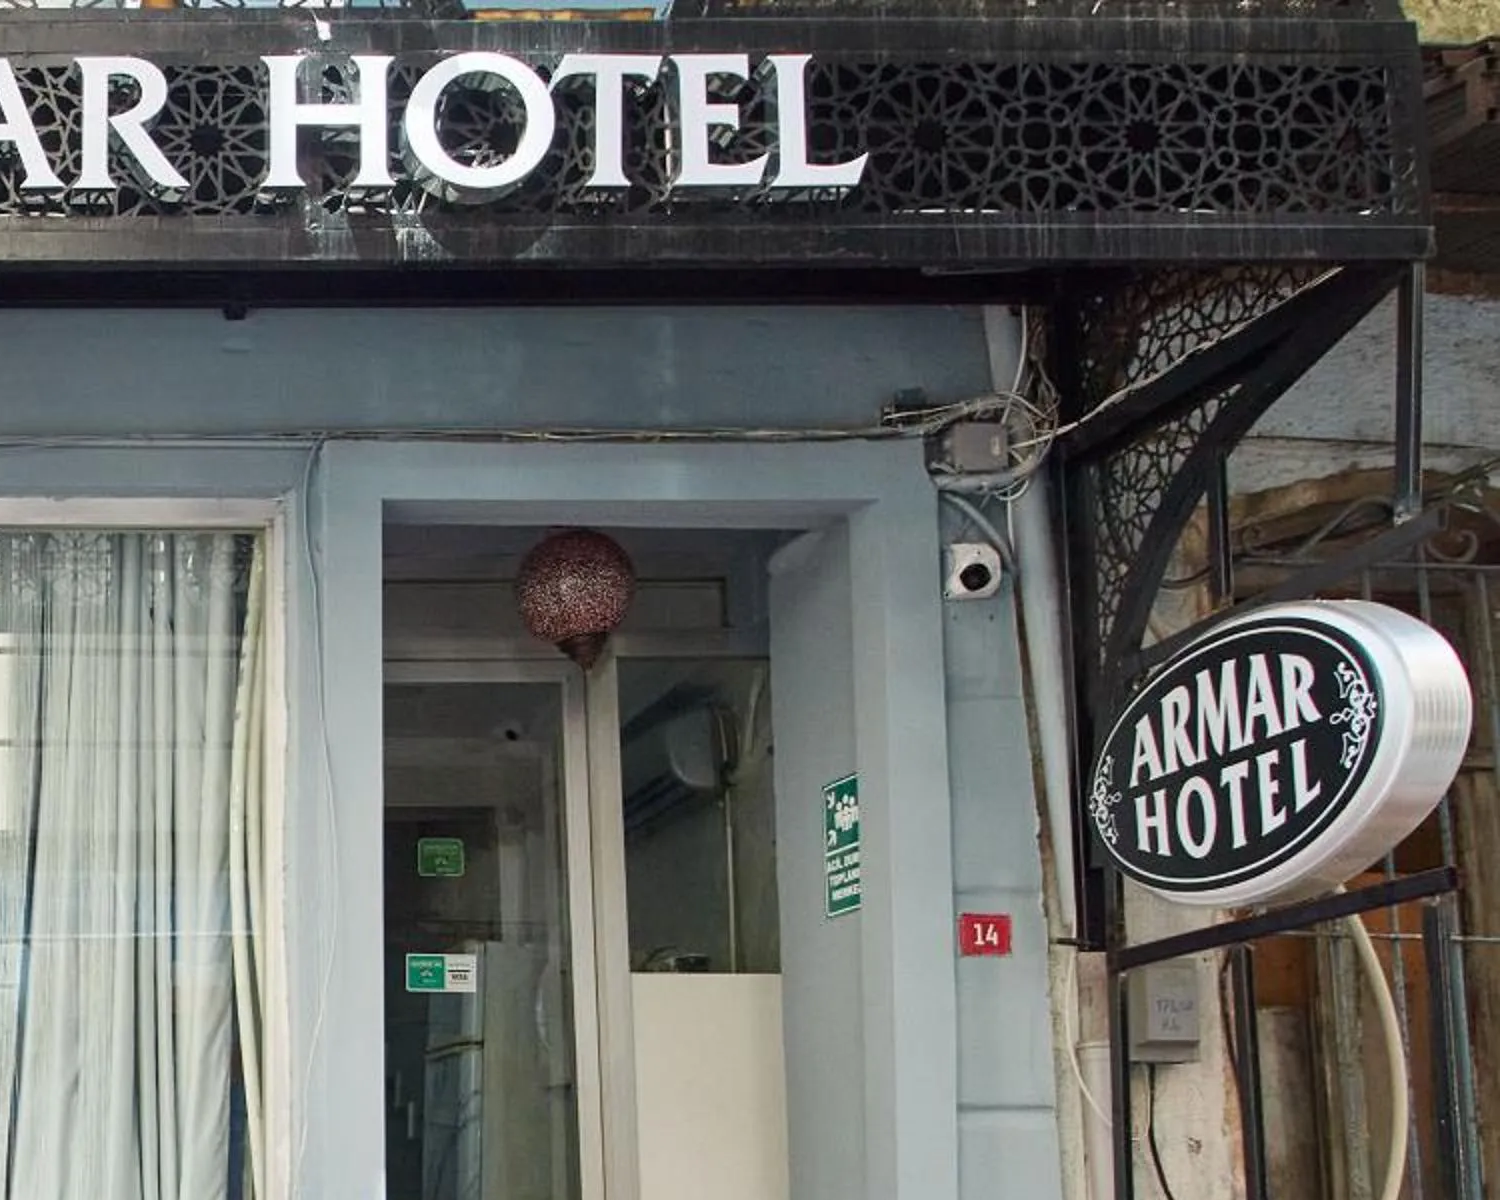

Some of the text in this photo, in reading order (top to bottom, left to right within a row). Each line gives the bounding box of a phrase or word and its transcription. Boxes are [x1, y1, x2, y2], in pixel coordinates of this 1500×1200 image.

[259, 51, 869, 187] HOTEL
[1129, 653, 1322, 788] ARMAR
[1134, 739, 1321, 859] HOTEL
[973, 923, 999, 946] 14
